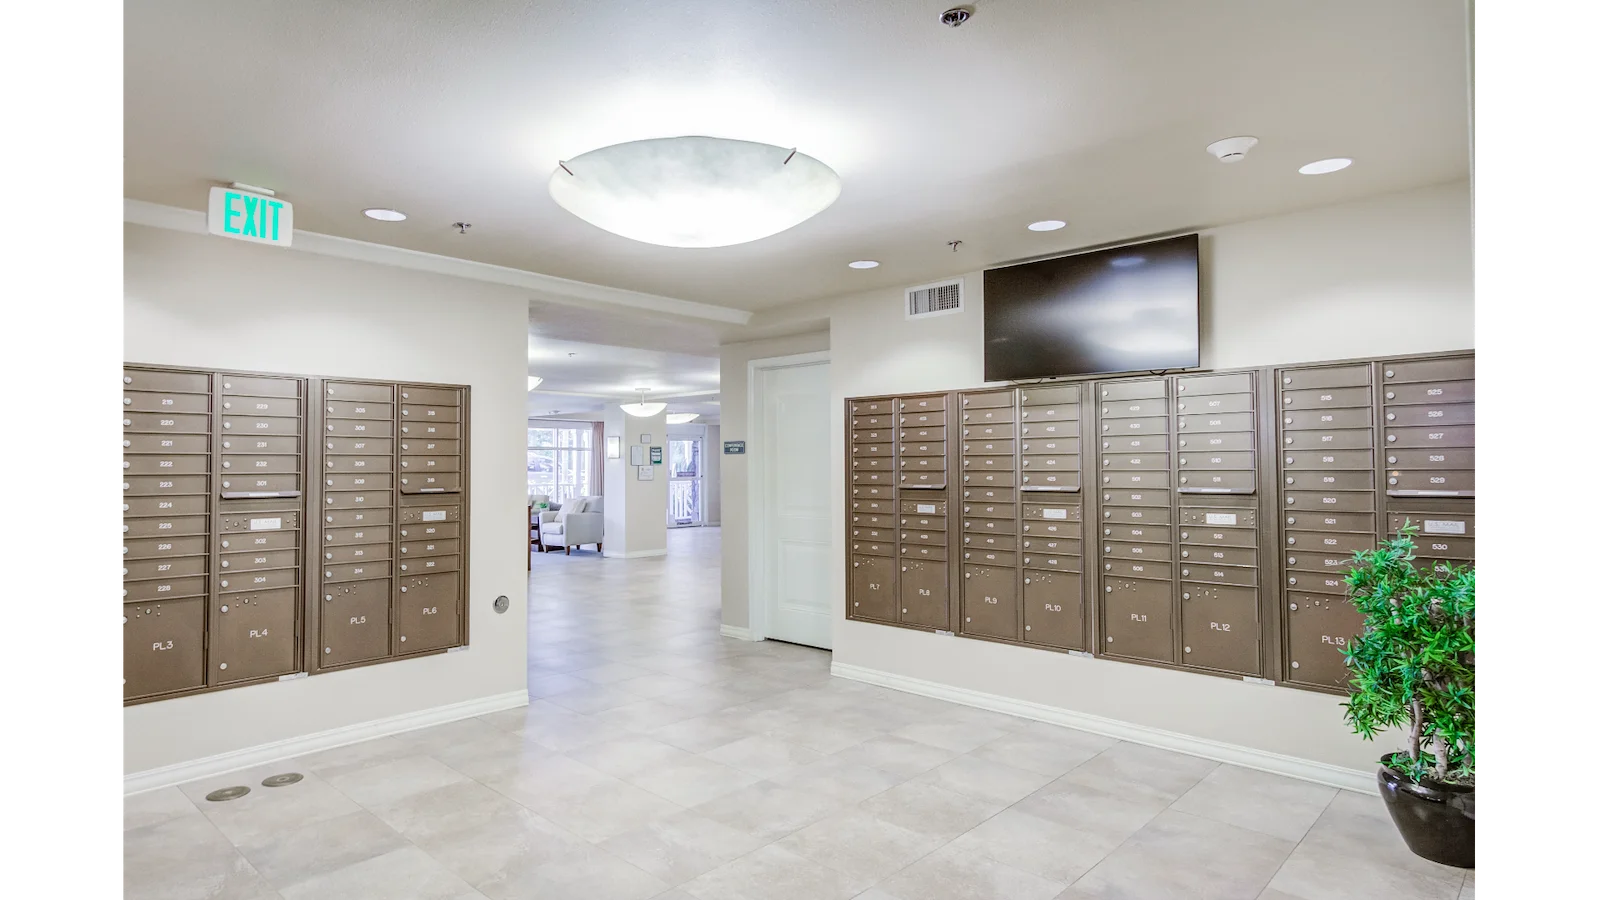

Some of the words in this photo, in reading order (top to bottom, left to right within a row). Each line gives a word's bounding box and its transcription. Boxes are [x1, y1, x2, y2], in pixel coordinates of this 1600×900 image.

[224, 192, 283, 240] EXIT
[918, 588, 930, 596] PL8
[984, 596, 998, 604] PL9
[422, 606, 438, 614] PL6
[1044, 604, 1062, 612] PL10
[350, 616, 366, 624] PL5
[1130, 614, 1146, 622] PL11
[1210, 622, 1230, 632] PL12
[250, 628, 268, 638] PL4
[1322, 634, 1346, 646] PL13
[152, 640, 174, 650] PL3
